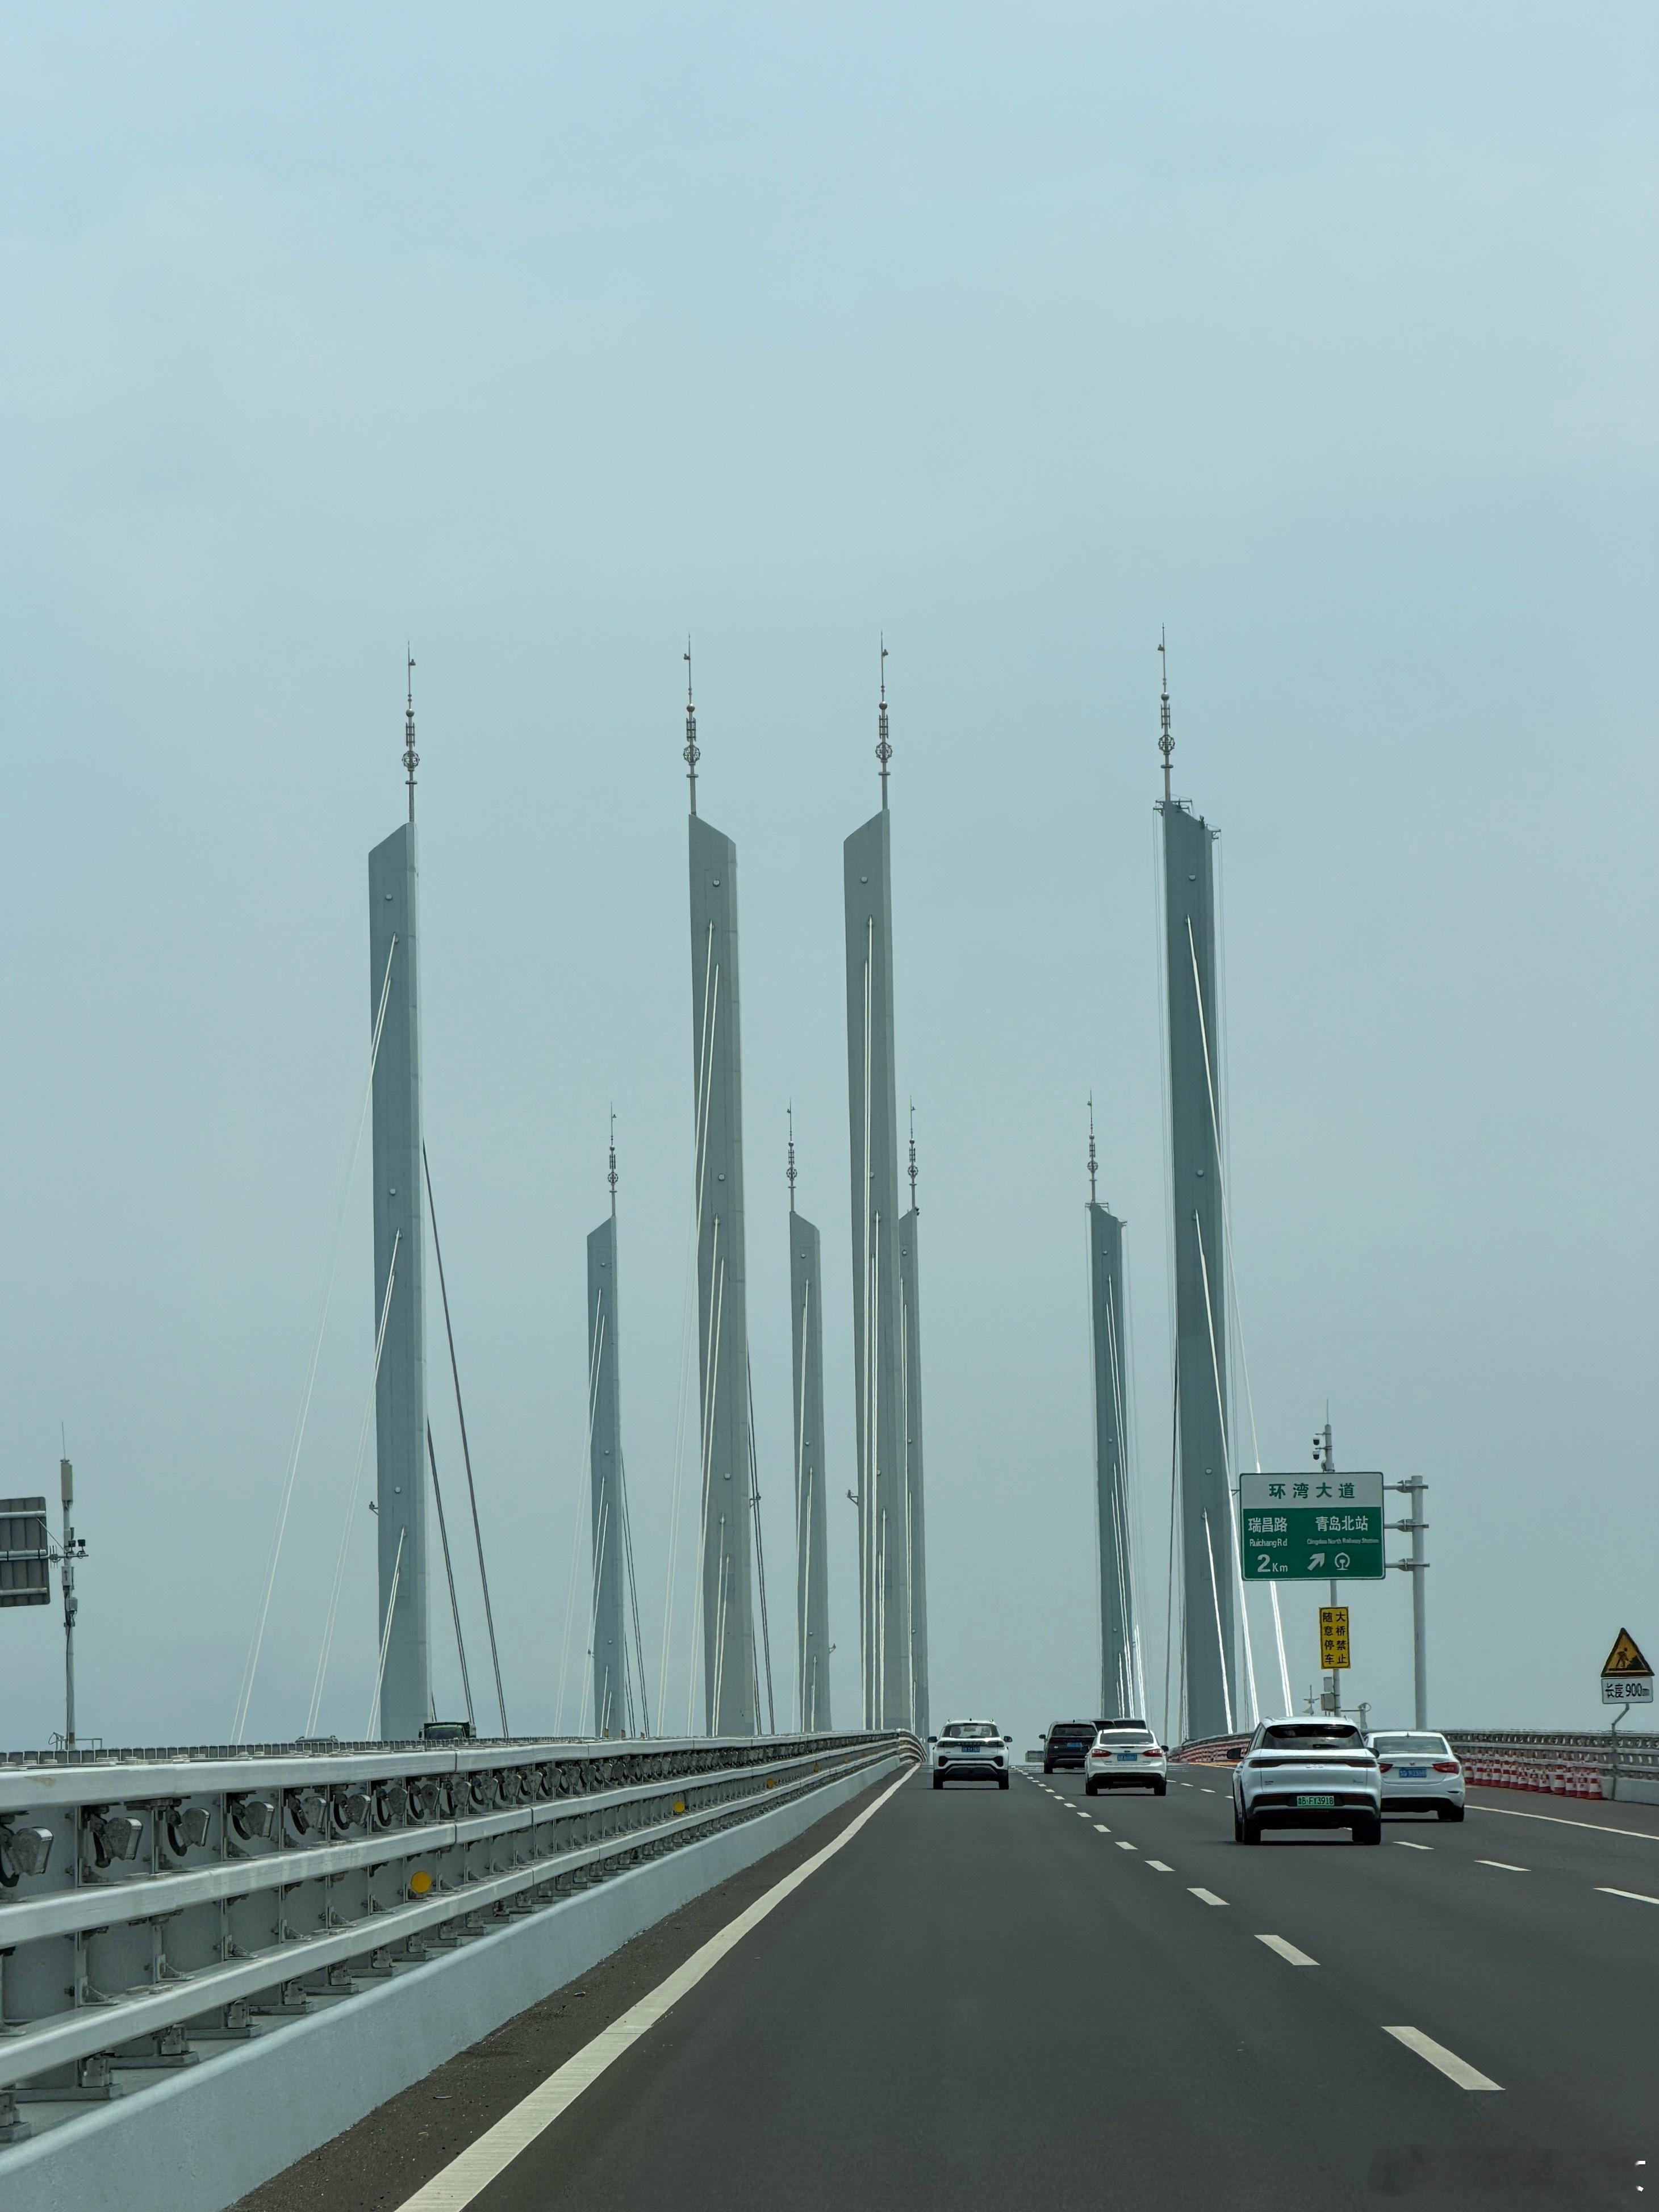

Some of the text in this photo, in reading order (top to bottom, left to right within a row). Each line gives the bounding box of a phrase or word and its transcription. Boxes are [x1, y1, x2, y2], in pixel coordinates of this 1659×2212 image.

[1269, 1482, 1355, 1499] 环湾大道
[1248, 1516, 1288, 1533] 瑞昌路
[1315, 1515, 1369, 1532] 青岛北站
[1250, 1538, 1276, 1548] Ruichang
[1322, 1612, 1335, 1665] 随意停车
[1336, 1611, 1348, 1664] 大桥禁止
